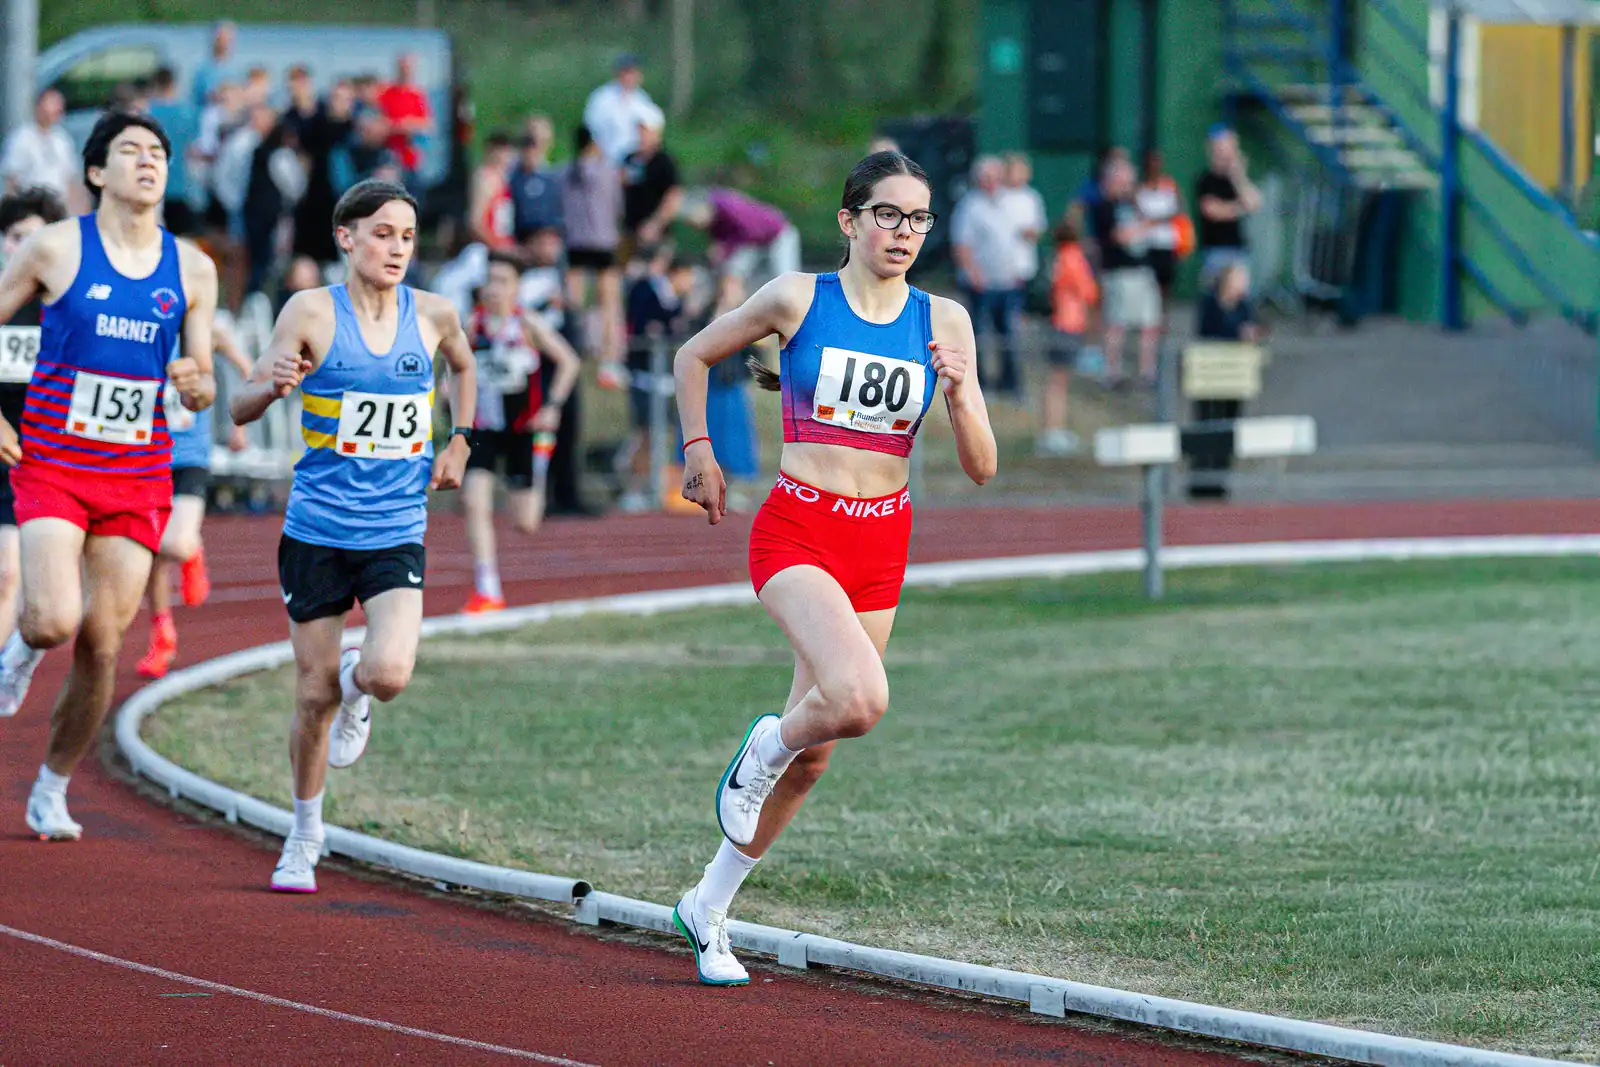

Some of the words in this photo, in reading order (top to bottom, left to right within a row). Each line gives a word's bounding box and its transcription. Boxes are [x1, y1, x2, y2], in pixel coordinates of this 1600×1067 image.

[96, 313, 160, 344] BARNET
[0, 335, 37, 364] 98
[839, 357, 911, 412] 180
[92, 384, 143, 422] 153
[355, 401, 417, 439] 213
[831, 498, 896, 518] NIKE
